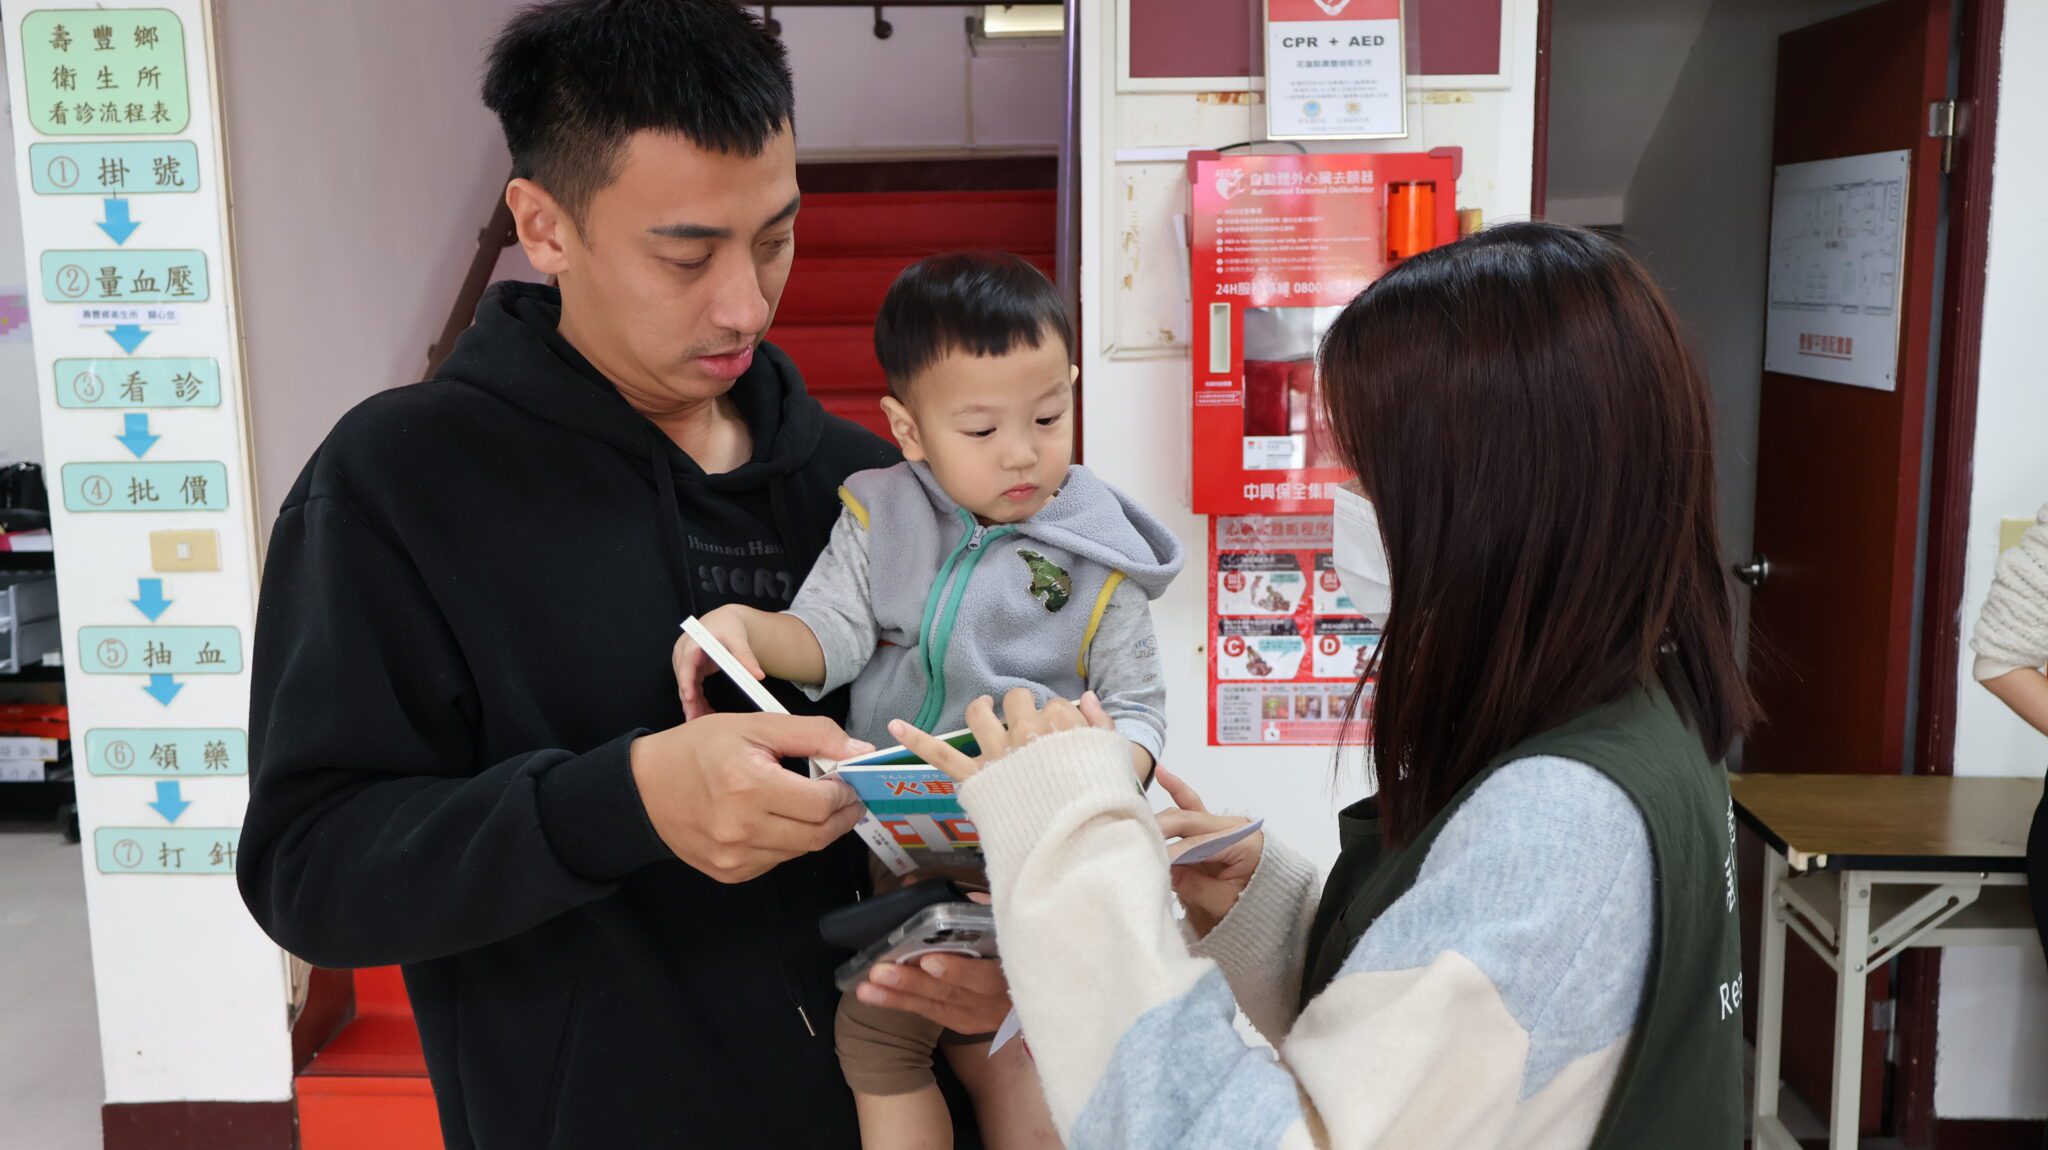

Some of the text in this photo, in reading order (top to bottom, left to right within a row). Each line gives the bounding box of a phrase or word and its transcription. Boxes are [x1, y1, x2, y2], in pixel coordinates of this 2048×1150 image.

[49, 24, 159, 52] 壽豐鄉
[1282, 37, 1318, 48] CPR
[1348, 35, 1384, 47] AED
[52, 65, 162, 91] 衛生所
[49, 100, 172, 125] 看診流程表
[97, 156, 185, 188] 掛號
[1251, 188, 1294, 196] Automated
[1296, 187, 1327, 195] External
[96, 265, 195, 298] 量血壓
[120, 370, 203, 403] 看診
[127, 475, 208, 505] 批價
[688, 535, 746, 556] Human
[143, 640, 226, 668] 抽血
[1228, 640, 1241, 653] C
[1323, 639, 1337, 653] D
[148, 740, 230, 771] 領藥
[158, 841, 236, 870] 打針
